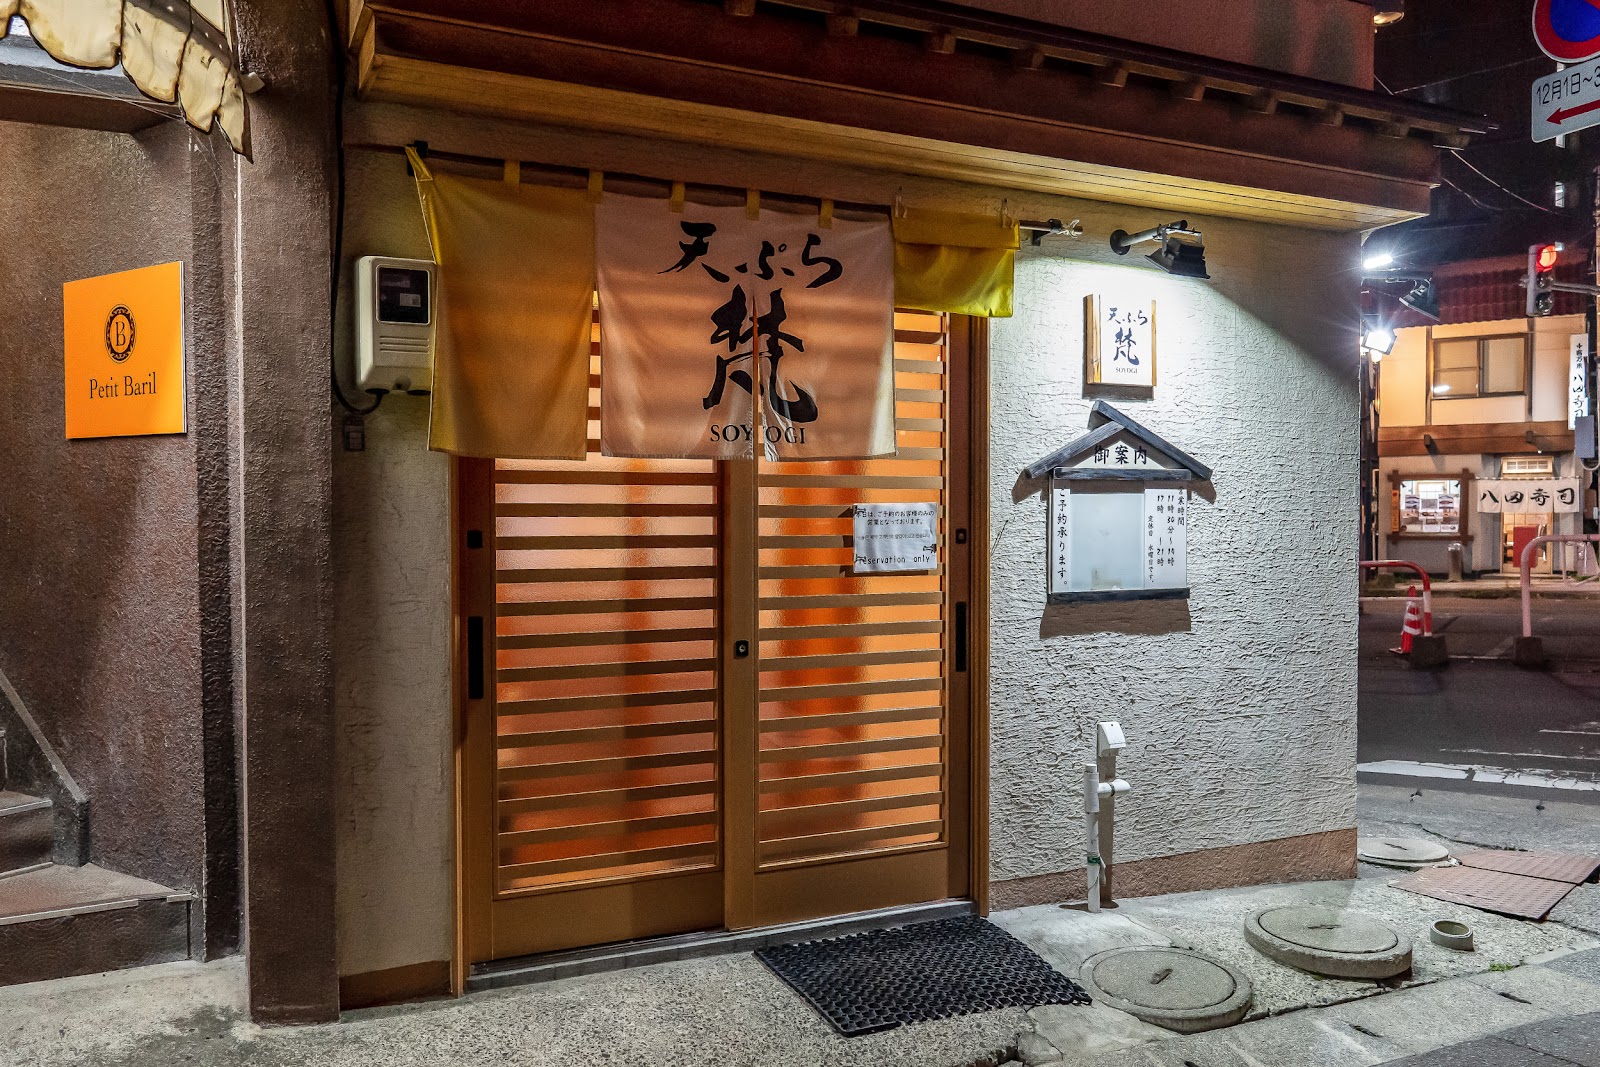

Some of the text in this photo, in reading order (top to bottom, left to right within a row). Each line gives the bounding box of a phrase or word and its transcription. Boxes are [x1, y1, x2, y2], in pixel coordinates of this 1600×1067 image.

[657, 220, 843, 289] 天ぷら
[703, 284, 818, 423] 梵
[89, 371, 157, 399] Petit Baril
[1094, 444, 1147, 465] 御案内
[913, 554, 930, 563] only
